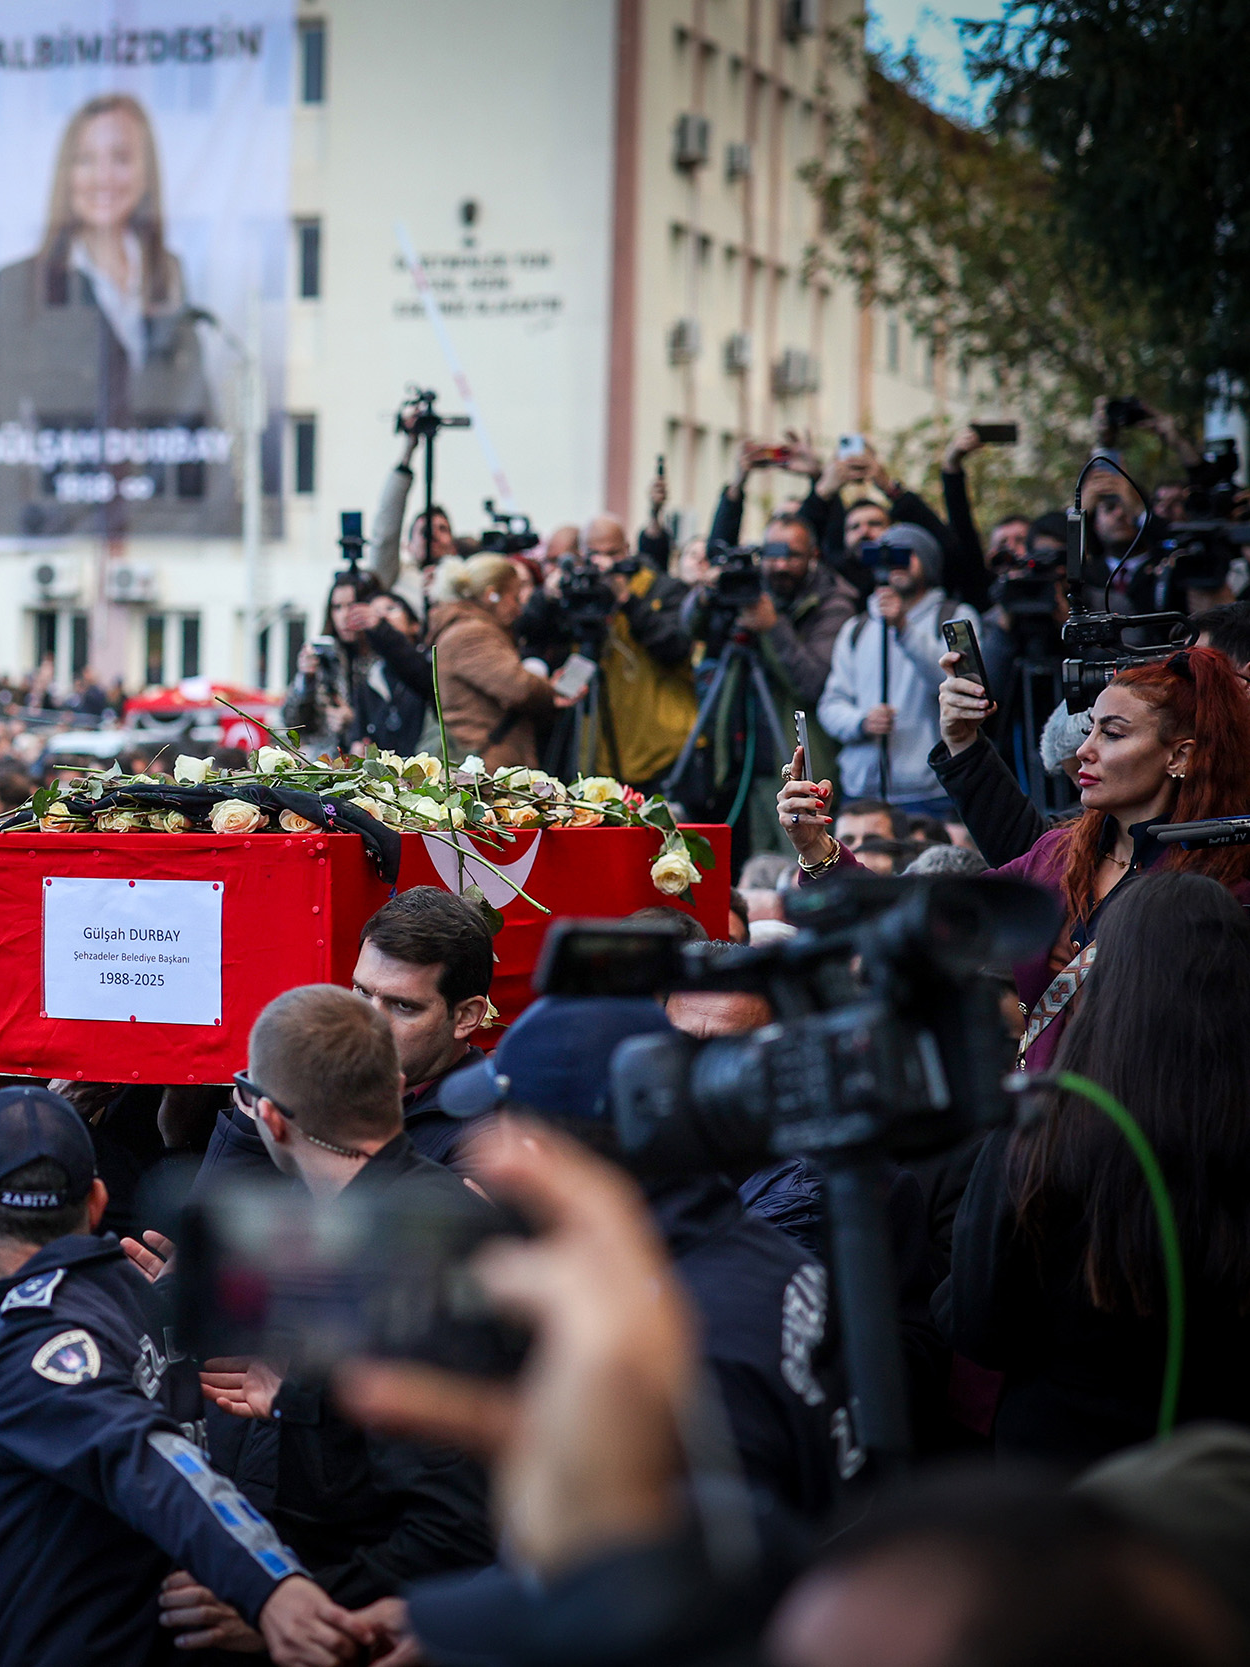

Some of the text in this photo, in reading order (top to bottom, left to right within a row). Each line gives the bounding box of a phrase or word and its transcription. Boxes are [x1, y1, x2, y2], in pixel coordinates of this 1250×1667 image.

[83, 927, 181, 943] Gülşah DURBAY
[73, 950, 190, 965] Şehzadeler Belediye Başkanı
[99, 972, 165, 986] 1988-2025
[1, 1192, 59, 1207] ZABITA
